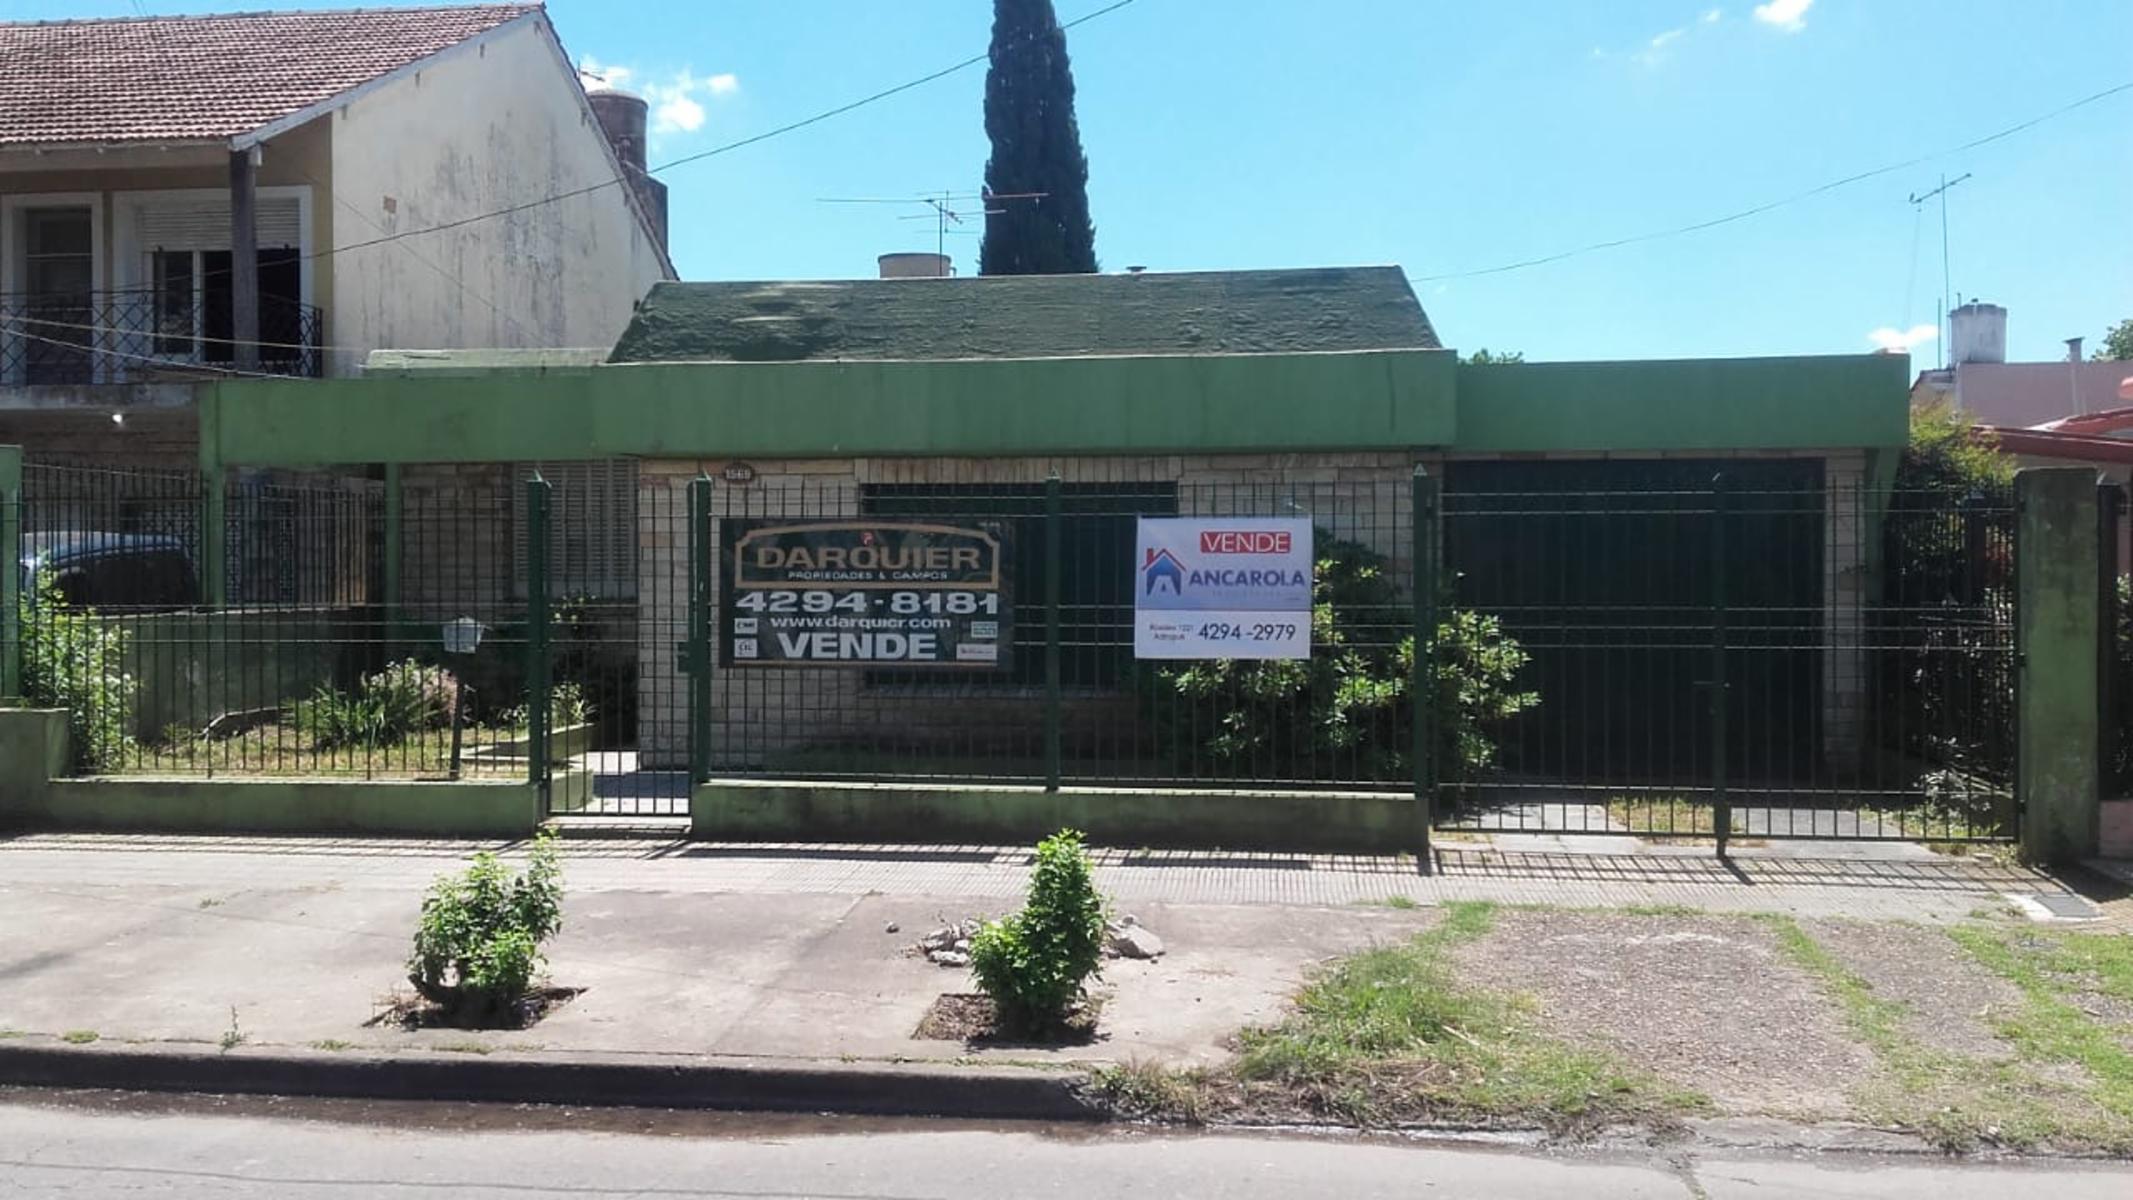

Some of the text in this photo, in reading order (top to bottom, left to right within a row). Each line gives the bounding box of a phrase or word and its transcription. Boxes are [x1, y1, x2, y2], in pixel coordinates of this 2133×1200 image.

[1203, 532, 1289, 552] VENDE
[757, 547, 980, 570] DARQUIER
[788, 571, 949, 581] PROPIEDADES & CAMPOS
[1188, 569, 1306, 587] ANCAROLA
[735, 591, 998, 614] 4294-8181
[770, 614, 951, 630] www.darquier.com
[1197, 622, 1297, 641] 4294-2979
[777, 633, 937, 660] VENDE
